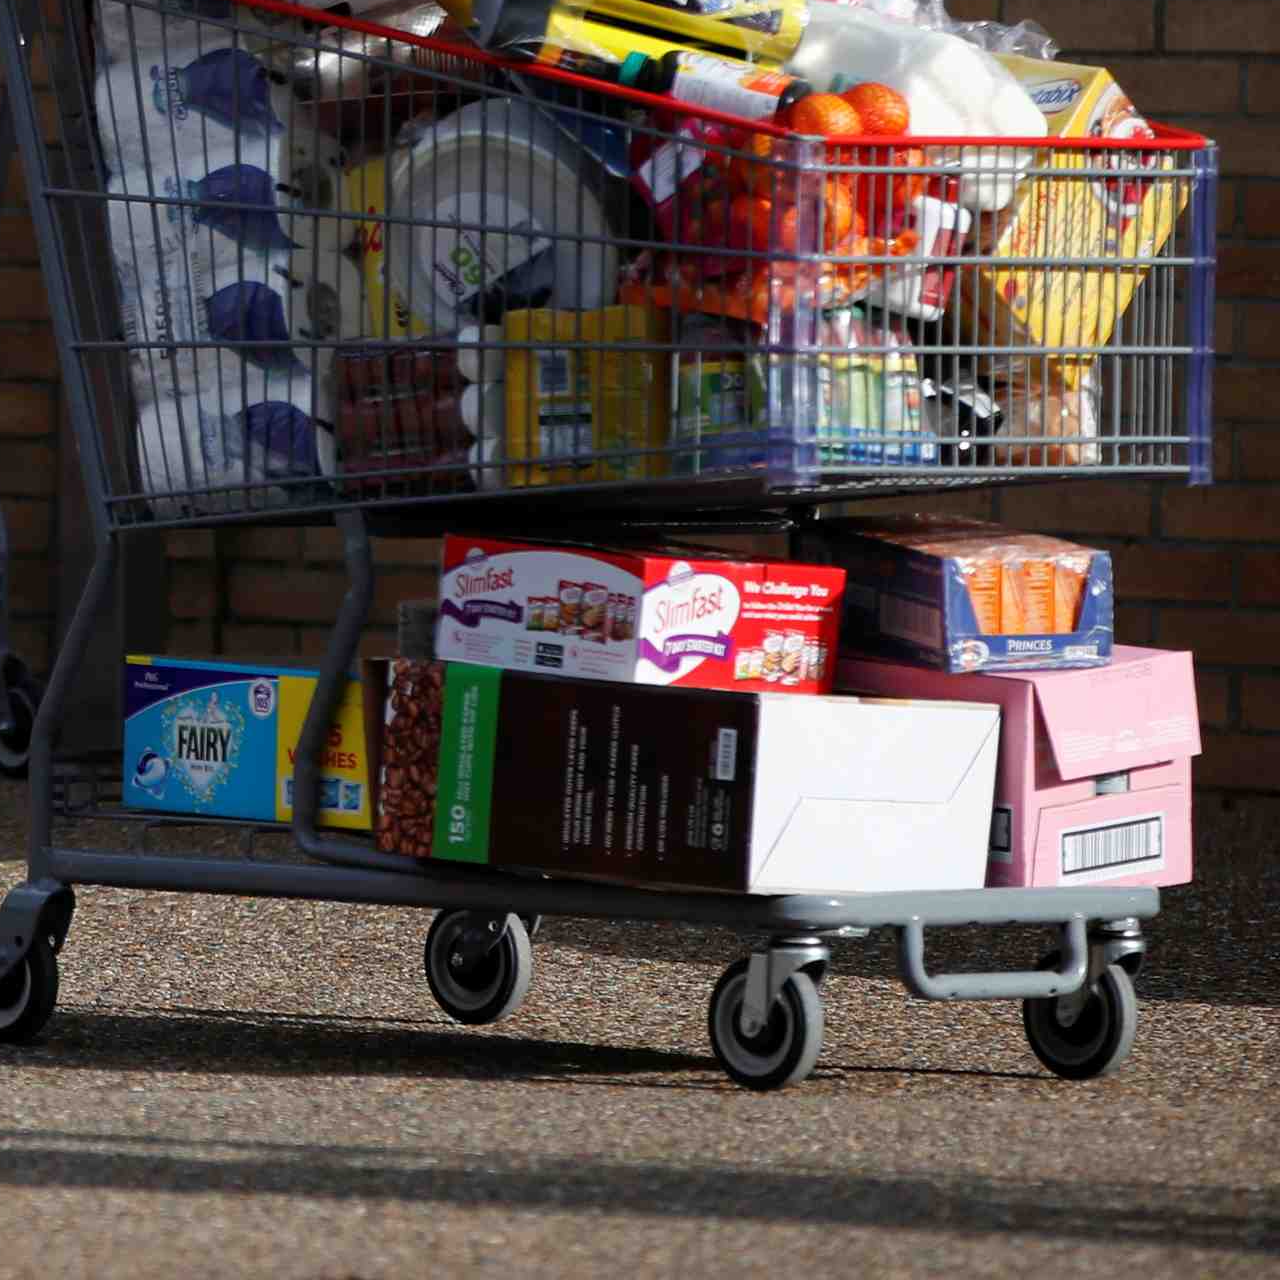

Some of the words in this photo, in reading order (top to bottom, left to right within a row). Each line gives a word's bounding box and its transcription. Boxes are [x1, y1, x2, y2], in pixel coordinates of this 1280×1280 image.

[655, 584, 724, 634] SlimFast
[743, 581, 761, 594] We
[762, 581, 809, 599] Challenge
[810, 583, 830, 597] You
[1007, 639, 1053, 652] PRINCES
[178, 723, 233, 763] FAIRY
[448, 804, 465, 845] 150
